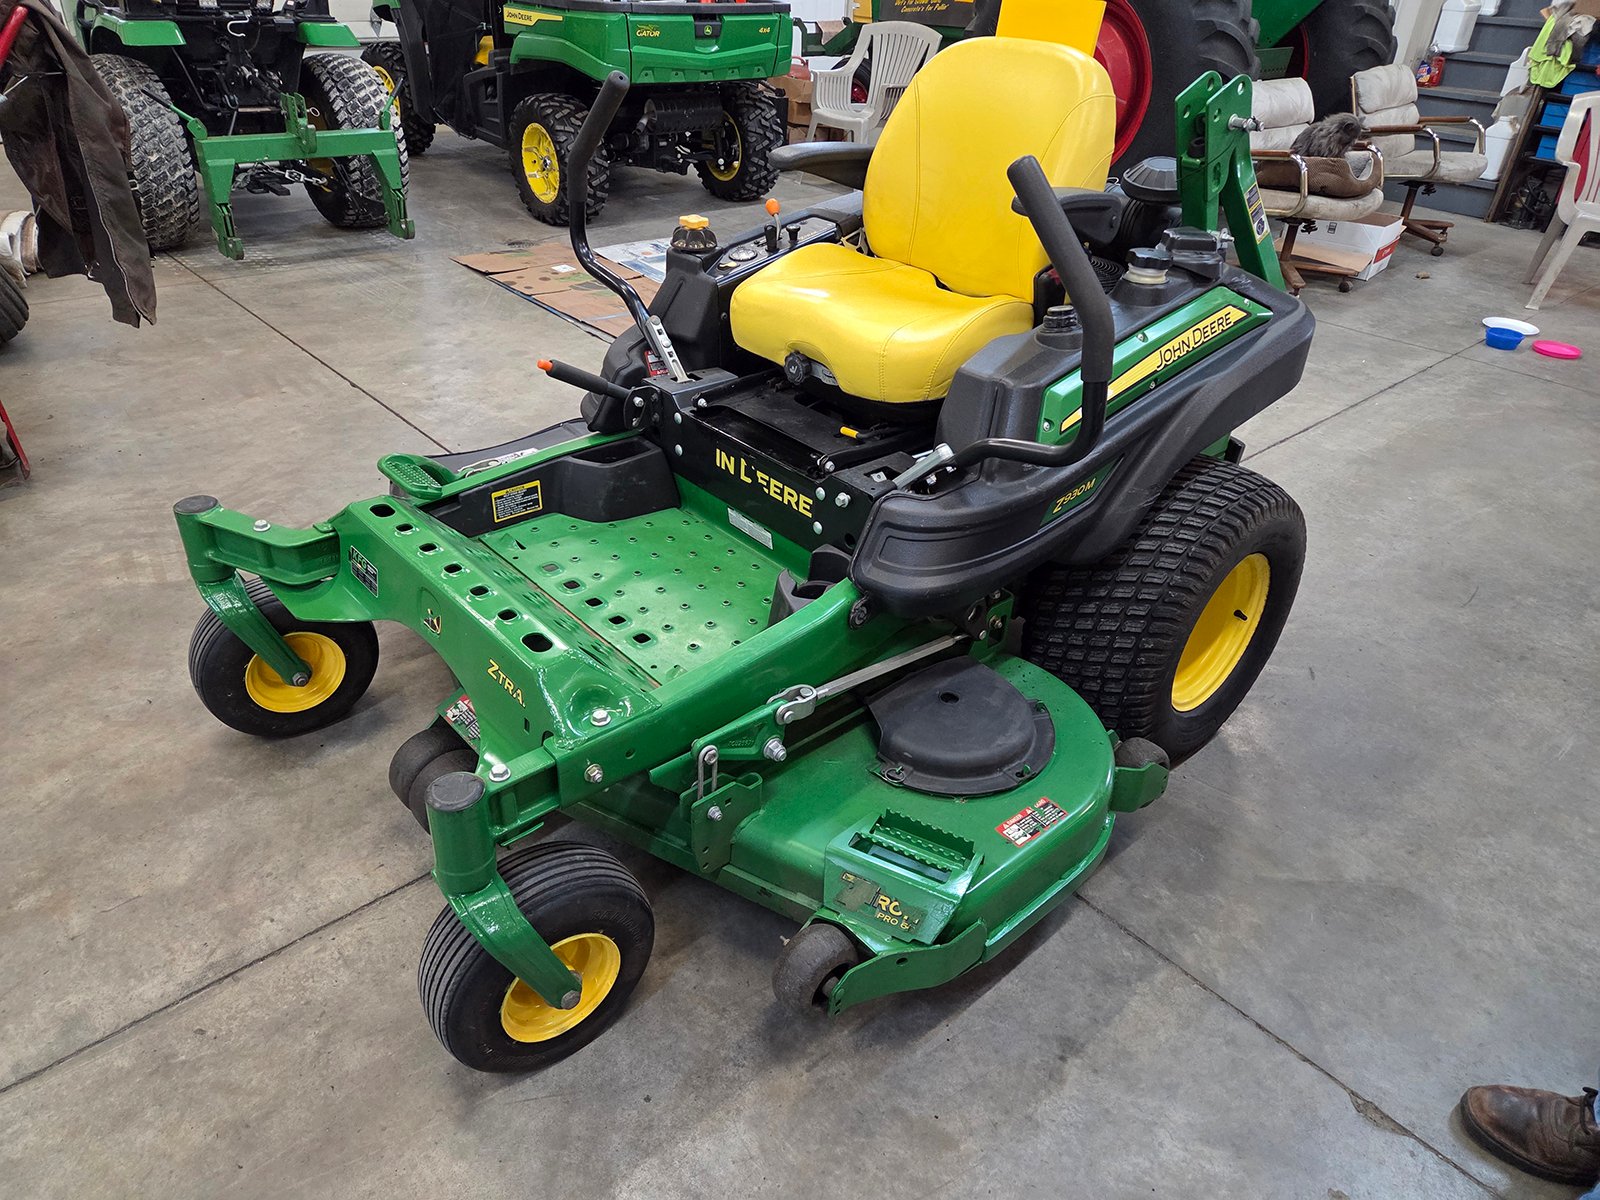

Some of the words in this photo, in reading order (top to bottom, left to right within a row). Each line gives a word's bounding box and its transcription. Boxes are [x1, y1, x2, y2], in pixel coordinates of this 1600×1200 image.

[506, 12, 518, 20] JOHN
[518, 12, 533, 22] DEERE
[636, 29, 661, 37] GATOR
[1156, 336, 1191, 370] JOHN
[1192, 311, 1233, 348] DEERE
[1052, 477, 1096, 514] Z930M
[487, 658, 526, 708] ZTRA
[877, 912, 899, 926] PRO
